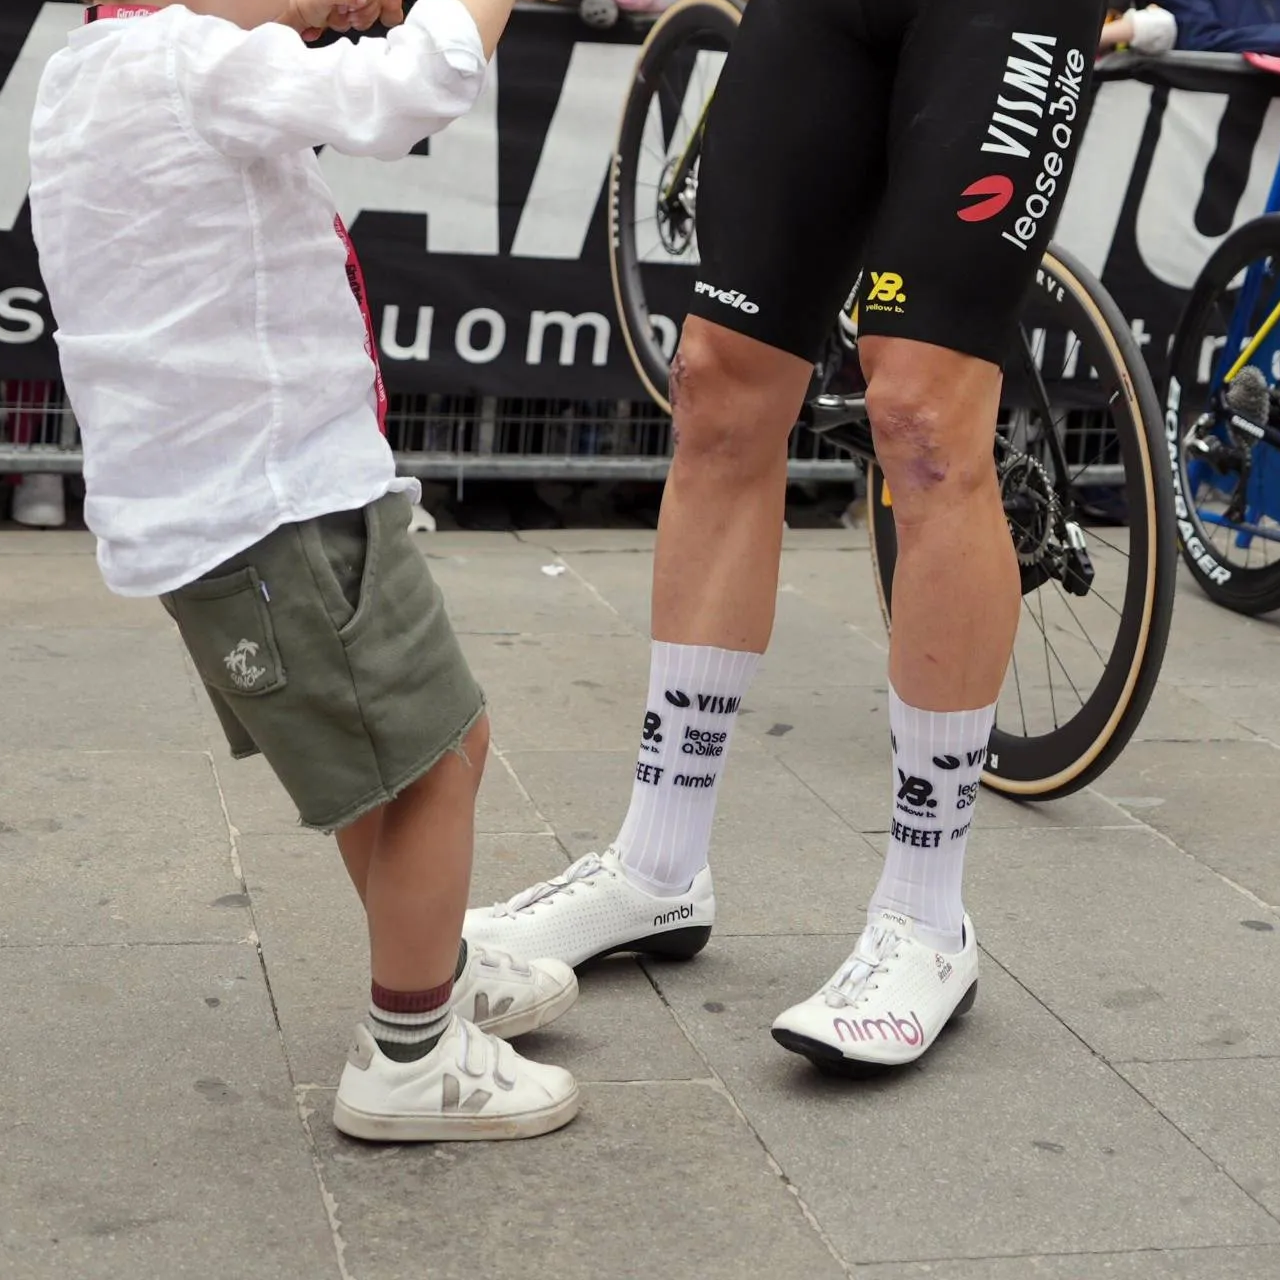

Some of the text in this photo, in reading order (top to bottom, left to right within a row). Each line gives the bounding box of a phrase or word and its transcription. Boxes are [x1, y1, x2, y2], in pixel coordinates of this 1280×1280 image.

[980, 31, 1057, 158] VISMA
[1001, 151, 1063, 251] lease
[694, 280, 760, 315] ervélo
[865, 303, 893, 313] yellow
[684, 726, 727, 743] lease
[673, 773, 716, 788] nimbl
[891, 816, 943, 848] DEFEET
[653, 903, 693, 927] nimbl
[882, 913, 907, 926] nimbl
[833, 1010, 925, 1046] nimbl
